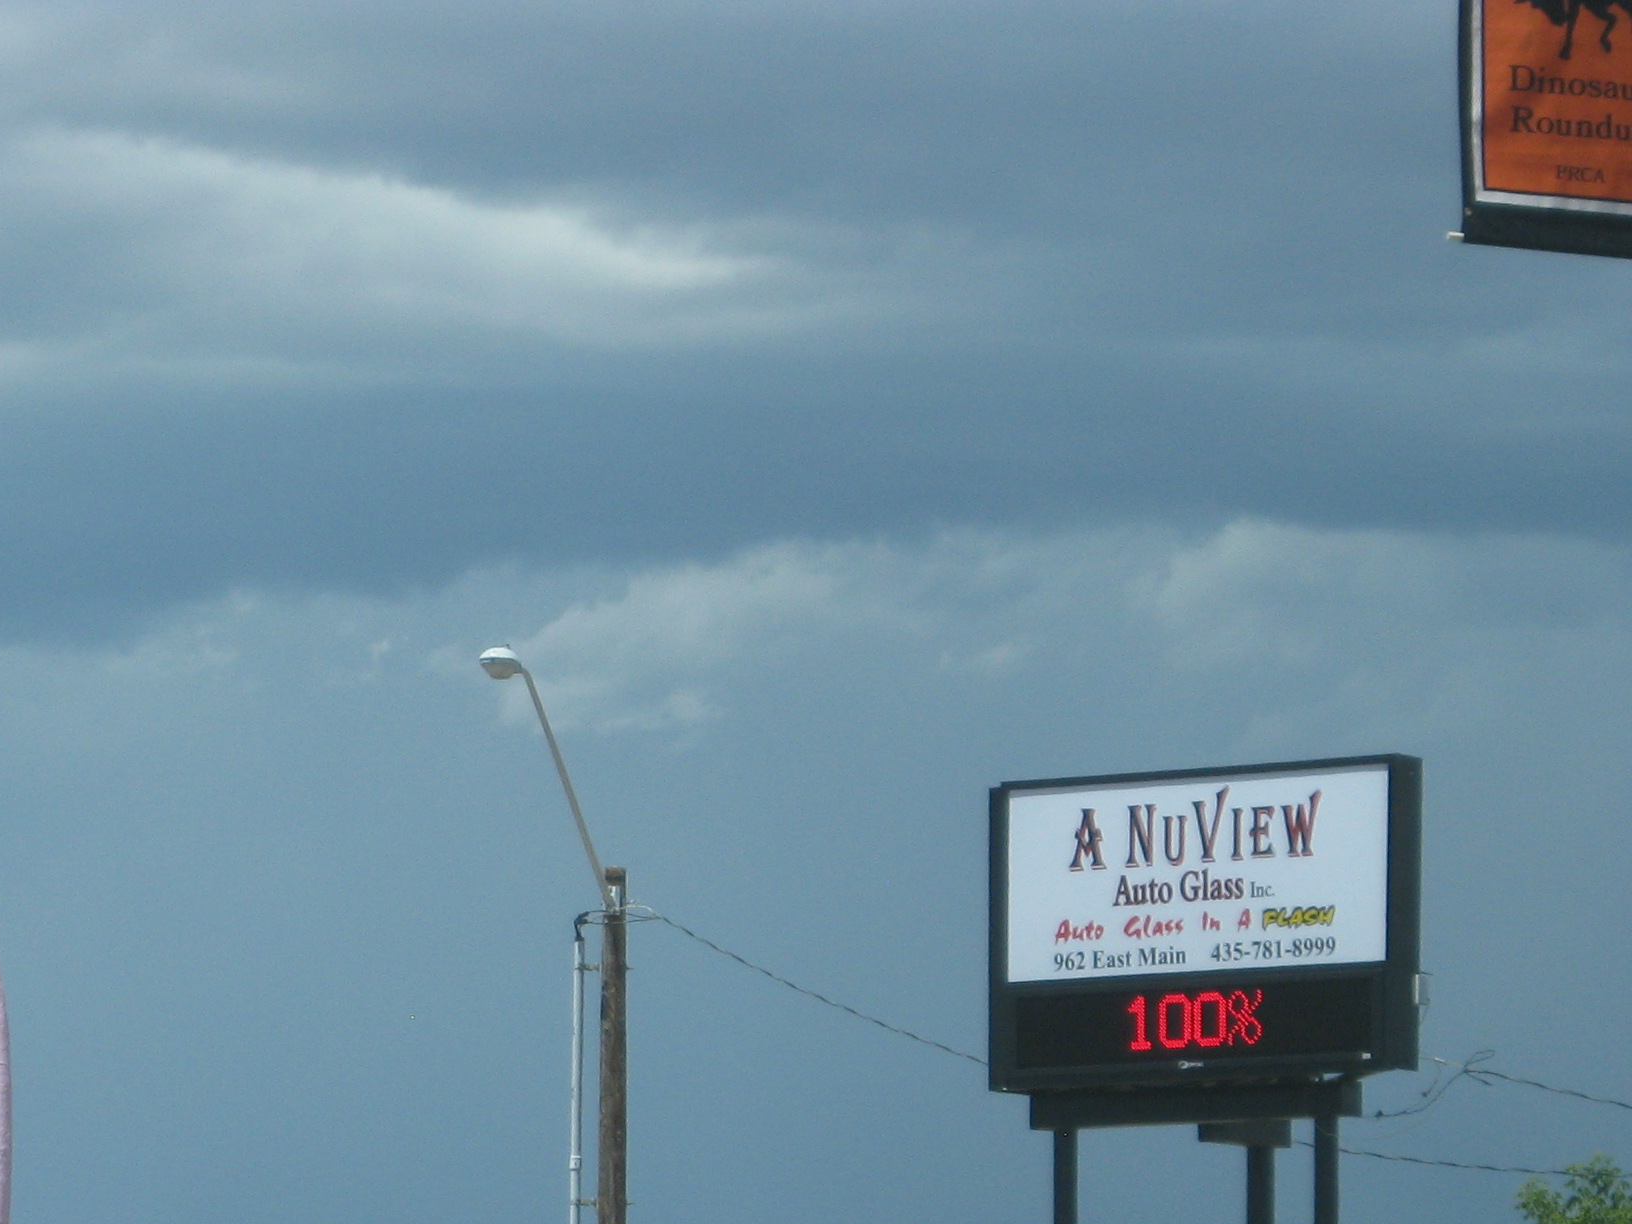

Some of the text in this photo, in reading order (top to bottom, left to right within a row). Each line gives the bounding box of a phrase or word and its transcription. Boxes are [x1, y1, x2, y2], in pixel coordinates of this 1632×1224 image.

[1555, 164, 1606, 184] PRCA
[1069, 807, 1107, 872] A
[1112, 867, 1276, 907] Auto Glass Inc.
[1054, 904, 1337, 945] Auto Glass In A FLASH
[1053, 935, 1337, 972] 962 East Main 435-781-8999
[1125, 987, 1264, 1051] 100%
